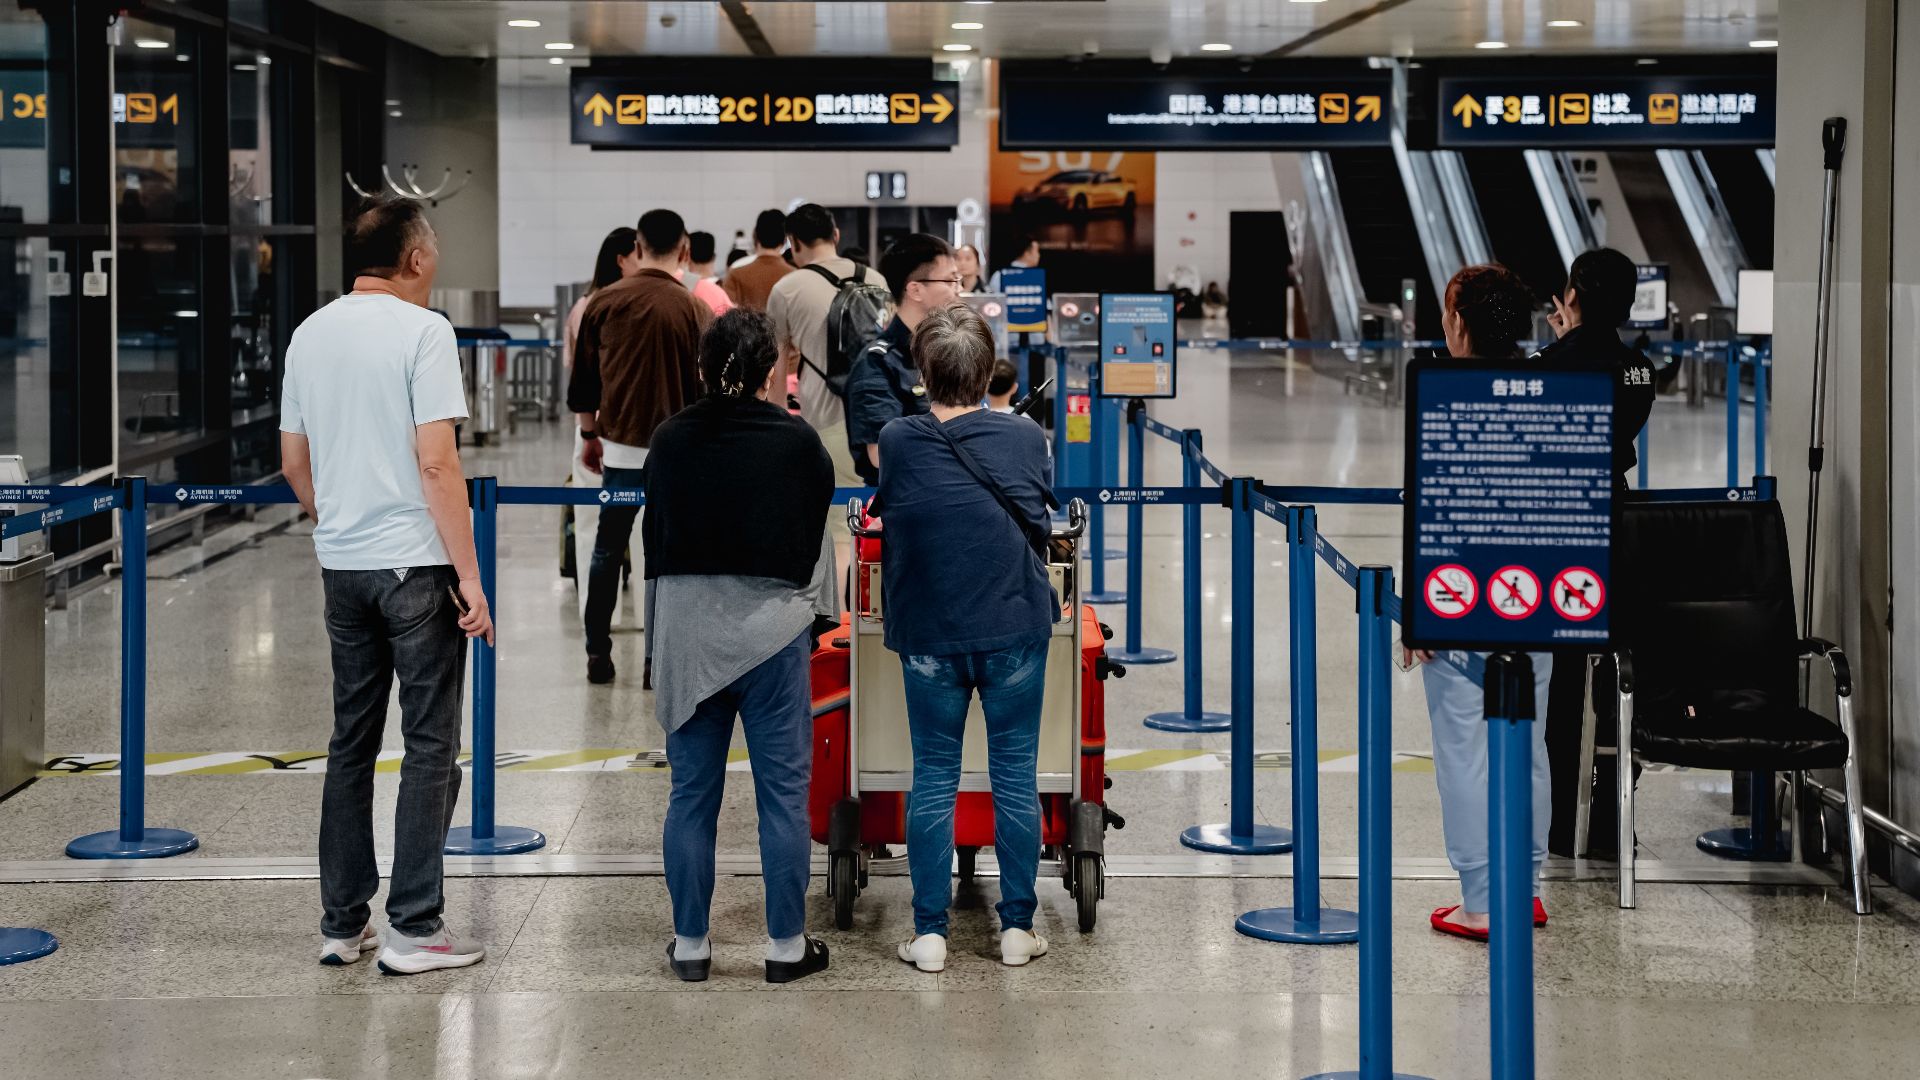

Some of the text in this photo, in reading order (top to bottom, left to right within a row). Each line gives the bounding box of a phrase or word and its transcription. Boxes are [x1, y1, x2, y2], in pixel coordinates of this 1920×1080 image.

[719, 96, 758, 122] 2C
[774, 96, 814, 122] 2D
[1592, 93, 1631, 113] 出发
[1492, 379, 1544, 397] 告知书
